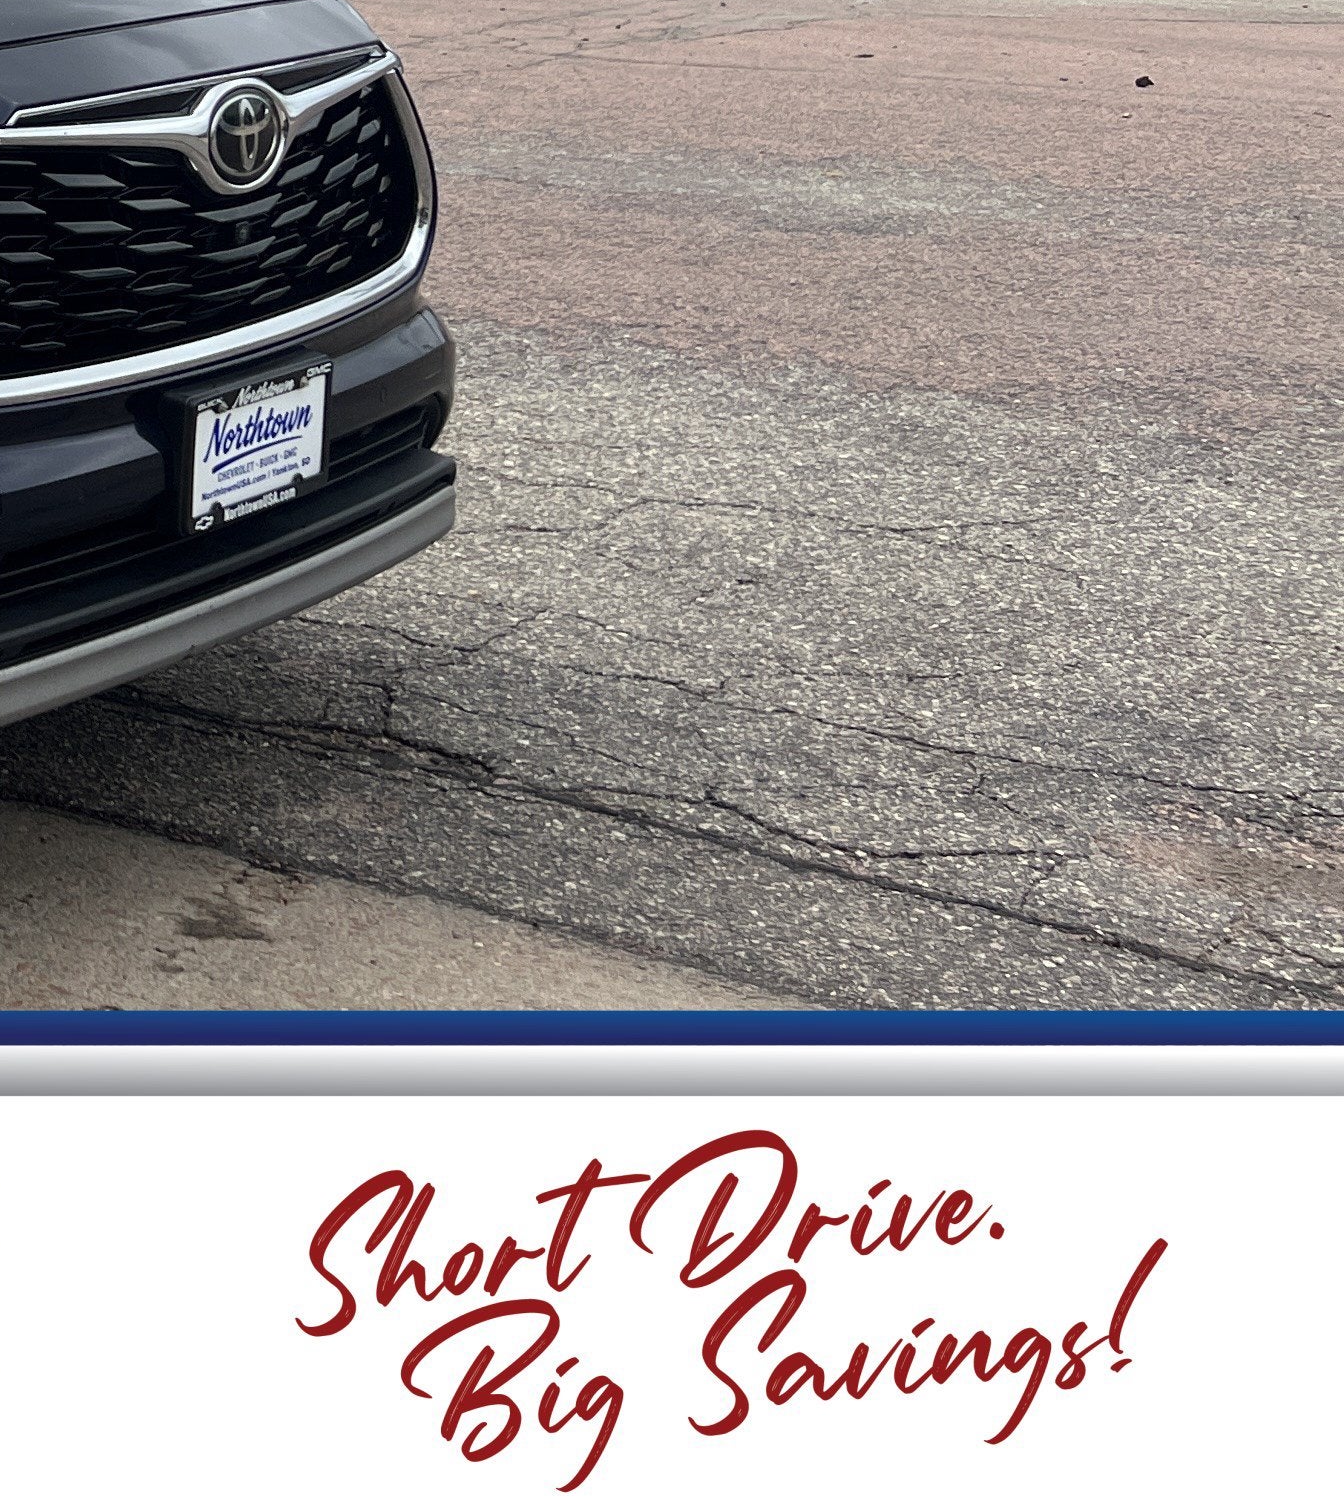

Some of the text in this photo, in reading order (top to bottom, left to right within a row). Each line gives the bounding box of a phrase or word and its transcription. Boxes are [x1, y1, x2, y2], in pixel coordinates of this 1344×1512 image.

[307, 362, 332, 378] GMC
[232, 378, 295, 408] Northtown
[202, 404, 313, 463] Northtown
[217, 446, 298, 483] CHEVROLET BUICK GMC
[201, 473, 267, 501] NorthtownUSA.com
[222, 486, 297, 522] NorthtownUSA.com
